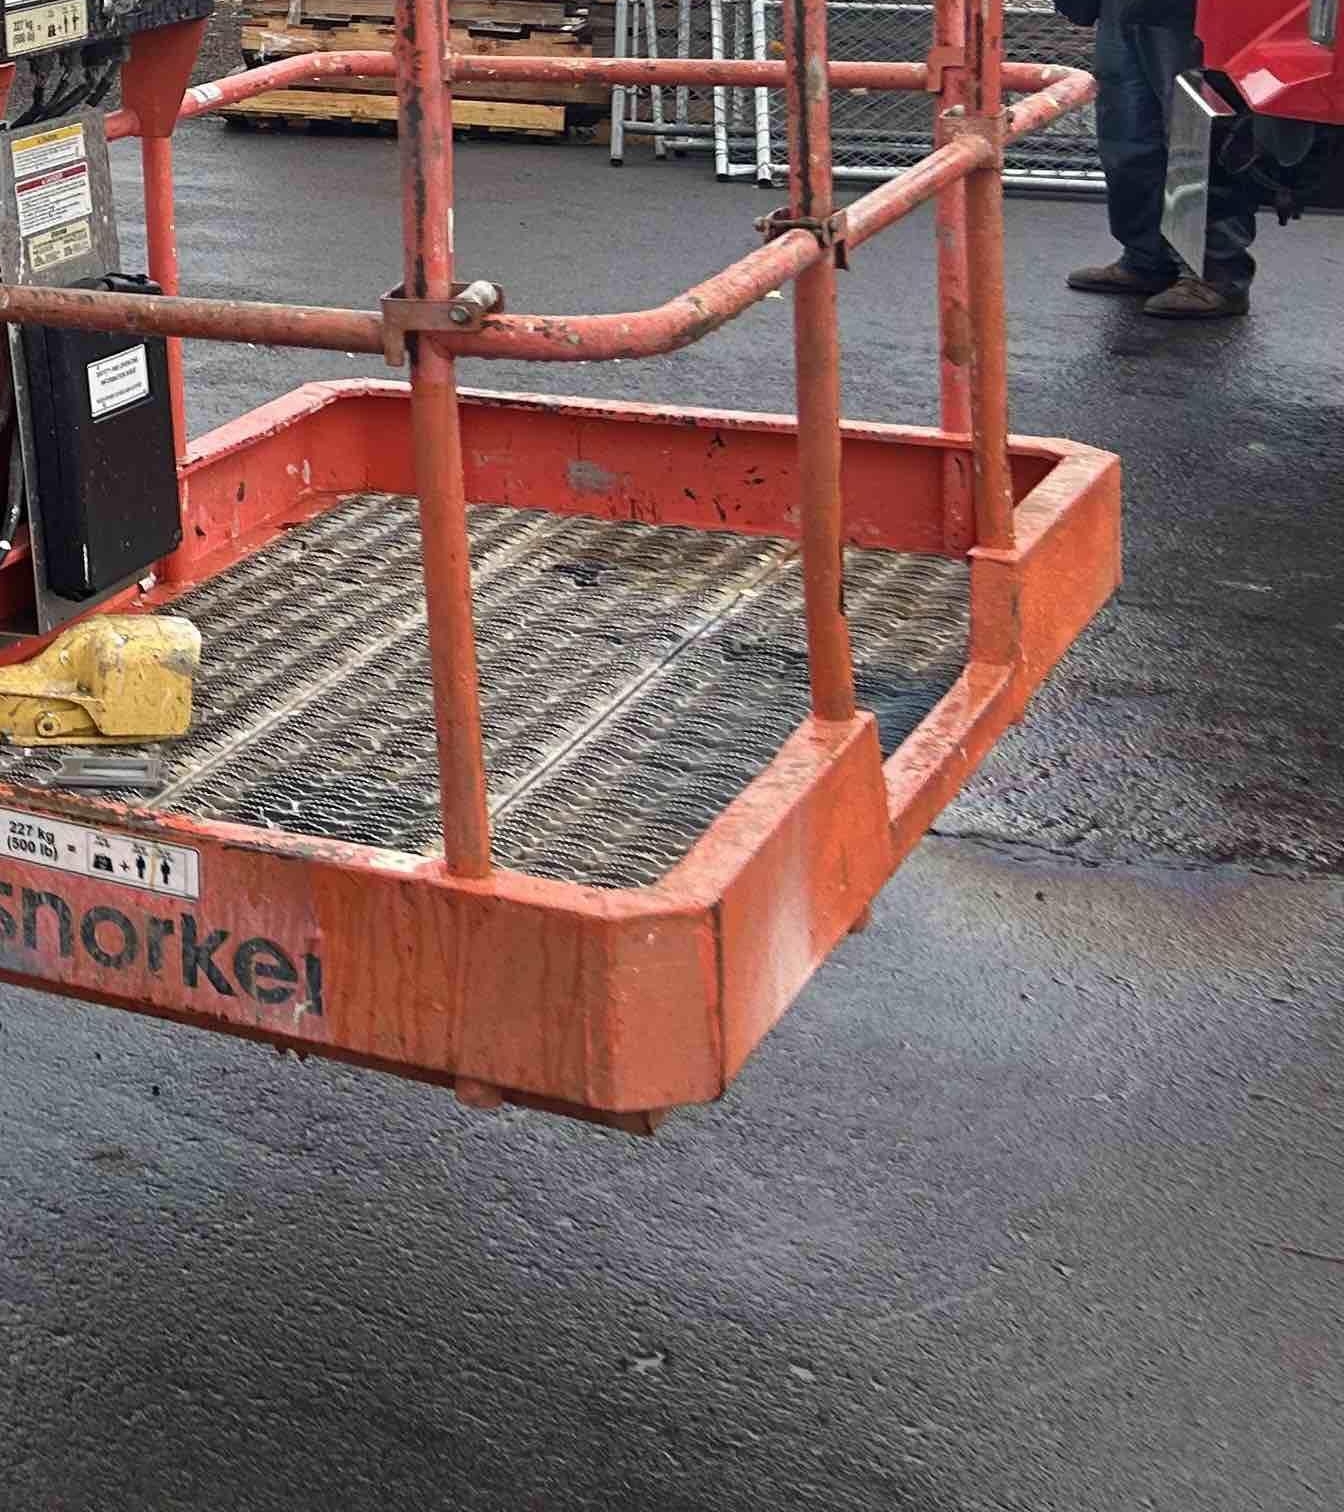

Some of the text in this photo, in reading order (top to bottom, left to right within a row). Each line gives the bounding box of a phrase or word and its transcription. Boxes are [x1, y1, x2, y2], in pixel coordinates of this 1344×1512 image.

[9, 821, 56, 845] 227 kg
[6, 835, 58, 862] (500 lb)
